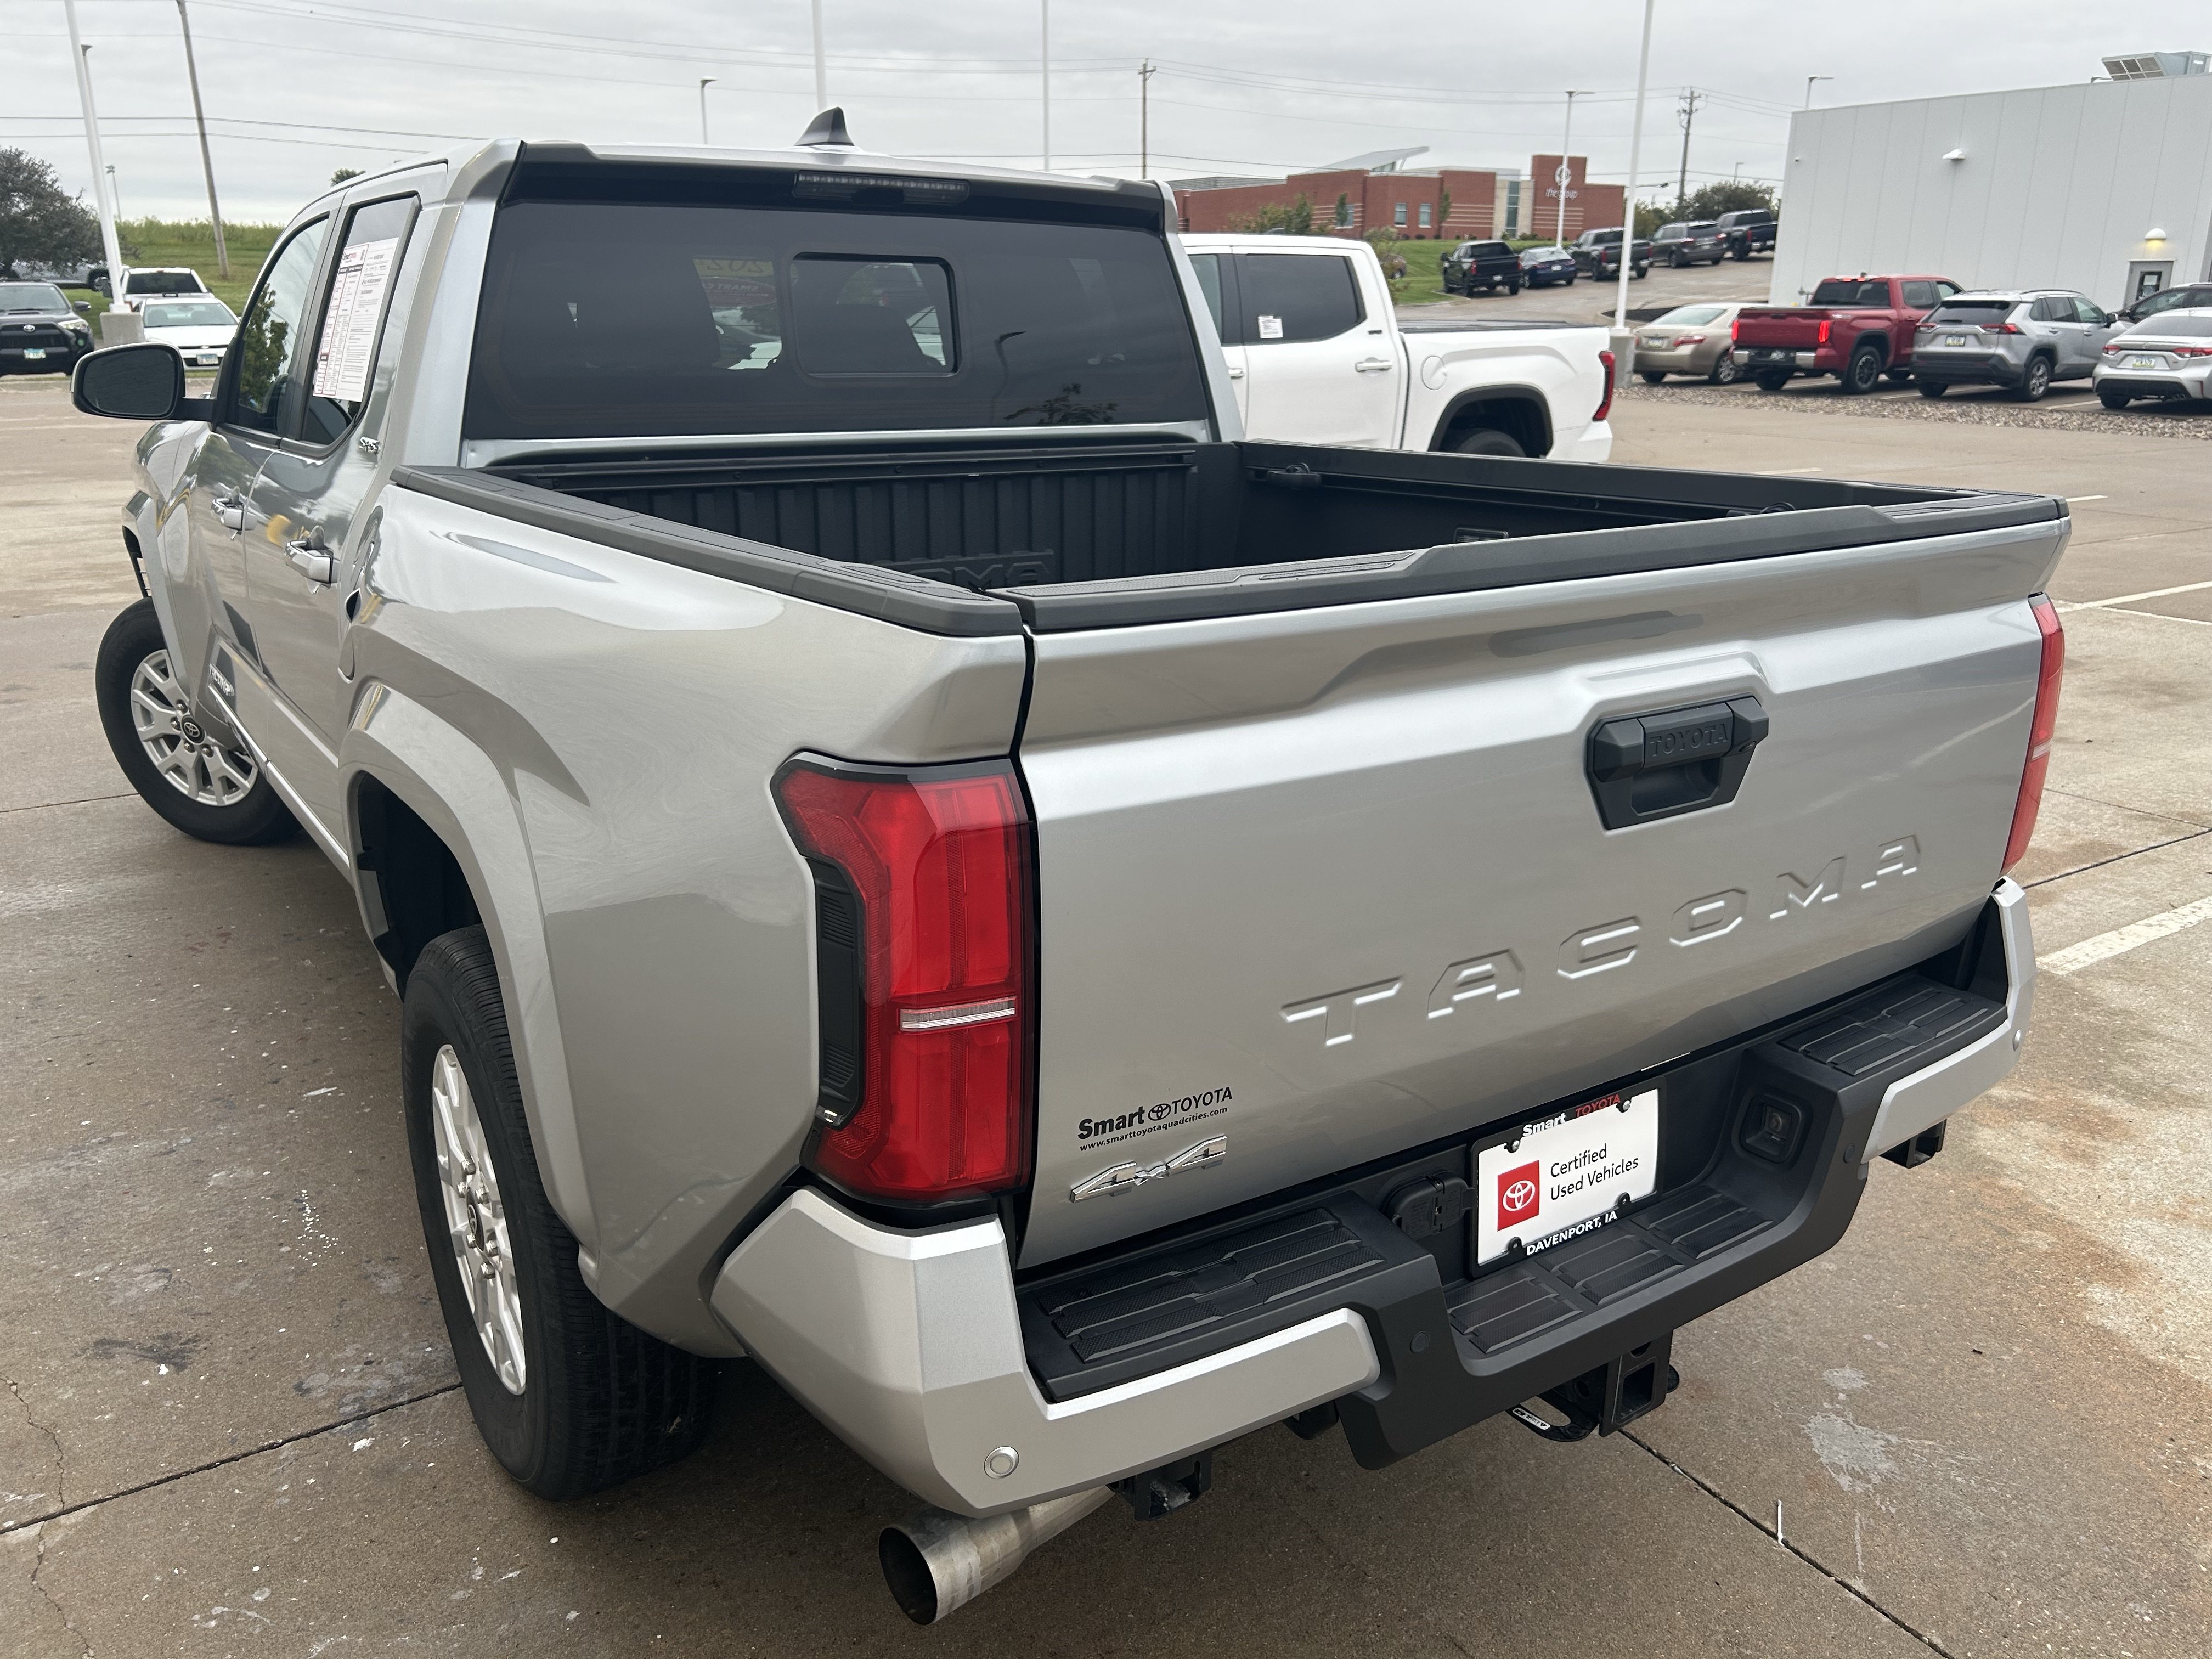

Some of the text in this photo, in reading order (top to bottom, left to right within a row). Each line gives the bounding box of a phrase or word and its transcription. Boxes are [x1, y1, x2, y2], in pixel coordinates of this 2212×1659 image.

[1649, 723, 1728, 758] TOYOTA
[1280, 834, 1920, 1047] TACOMA
[1077, 1086, 1233, 1139] Smart TOYOTA
[1079, 1106, 1228, 1152] www.smarttoyotaquadcities.com
[1522, 1093, 1621, 1137] Smart TOYOTA
[1550, 1143, 1607, 1178] Certified
[1551, 1158, 1639, 1200] Used Vehicles
[1526, 1211, 1617, 1256] DAVENPORT, IA
